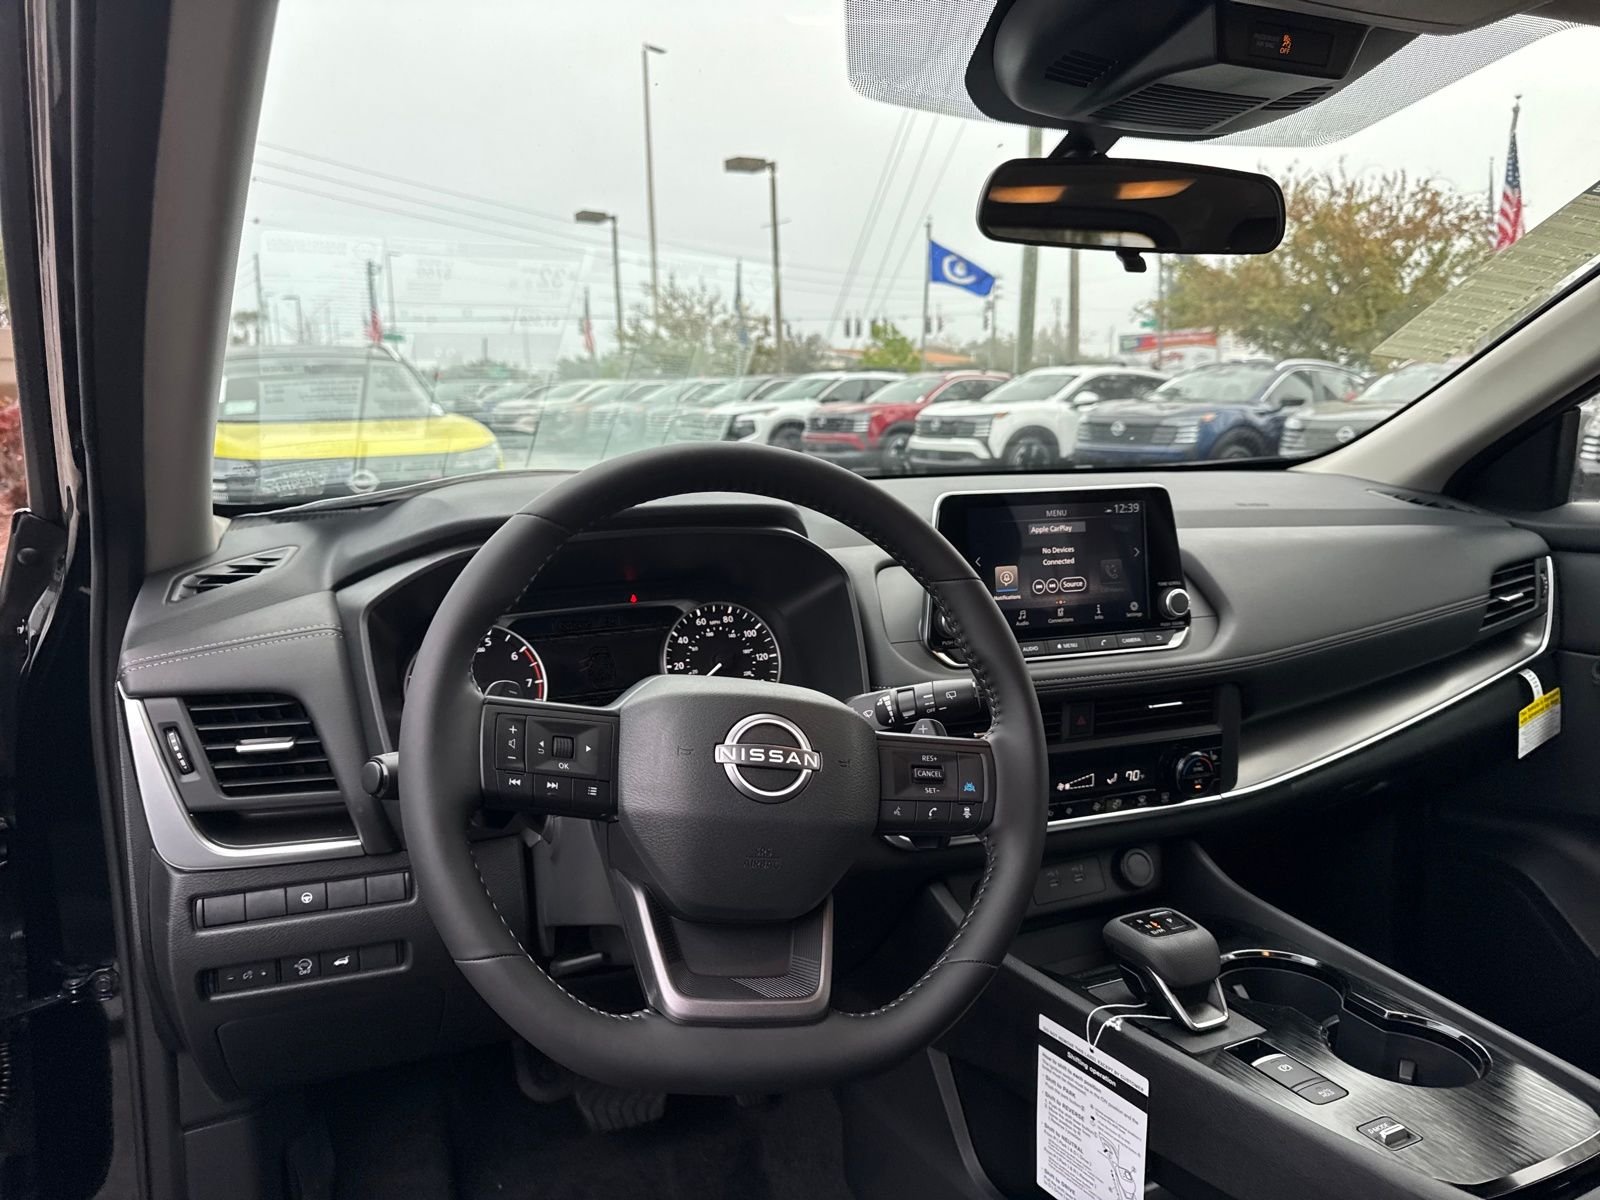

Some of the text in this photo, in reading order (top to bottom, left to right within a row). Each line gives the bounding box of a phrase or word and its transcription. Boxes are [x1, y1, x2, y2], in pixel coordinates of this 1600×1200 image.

[1114, 503, 1140, 513] 12:39
[1030, 524, 1072, 534] Apple CarPlay
[1043, 558, 1075, 566] Connected
[484, 638, 492, 646] 5
[678, 636, 689, 644] 40
[511, 652, 518, 660] 6
[674, 662, 684, 670] 20
[526, 679, 532, 687] 7
[720, 746, 818, 768] NISSAN
[1125, 770, 1140, 781] 70
[1067, 1050, 1088, 1070] Shifting
[1089, 1065, 1116, 1088] operation
